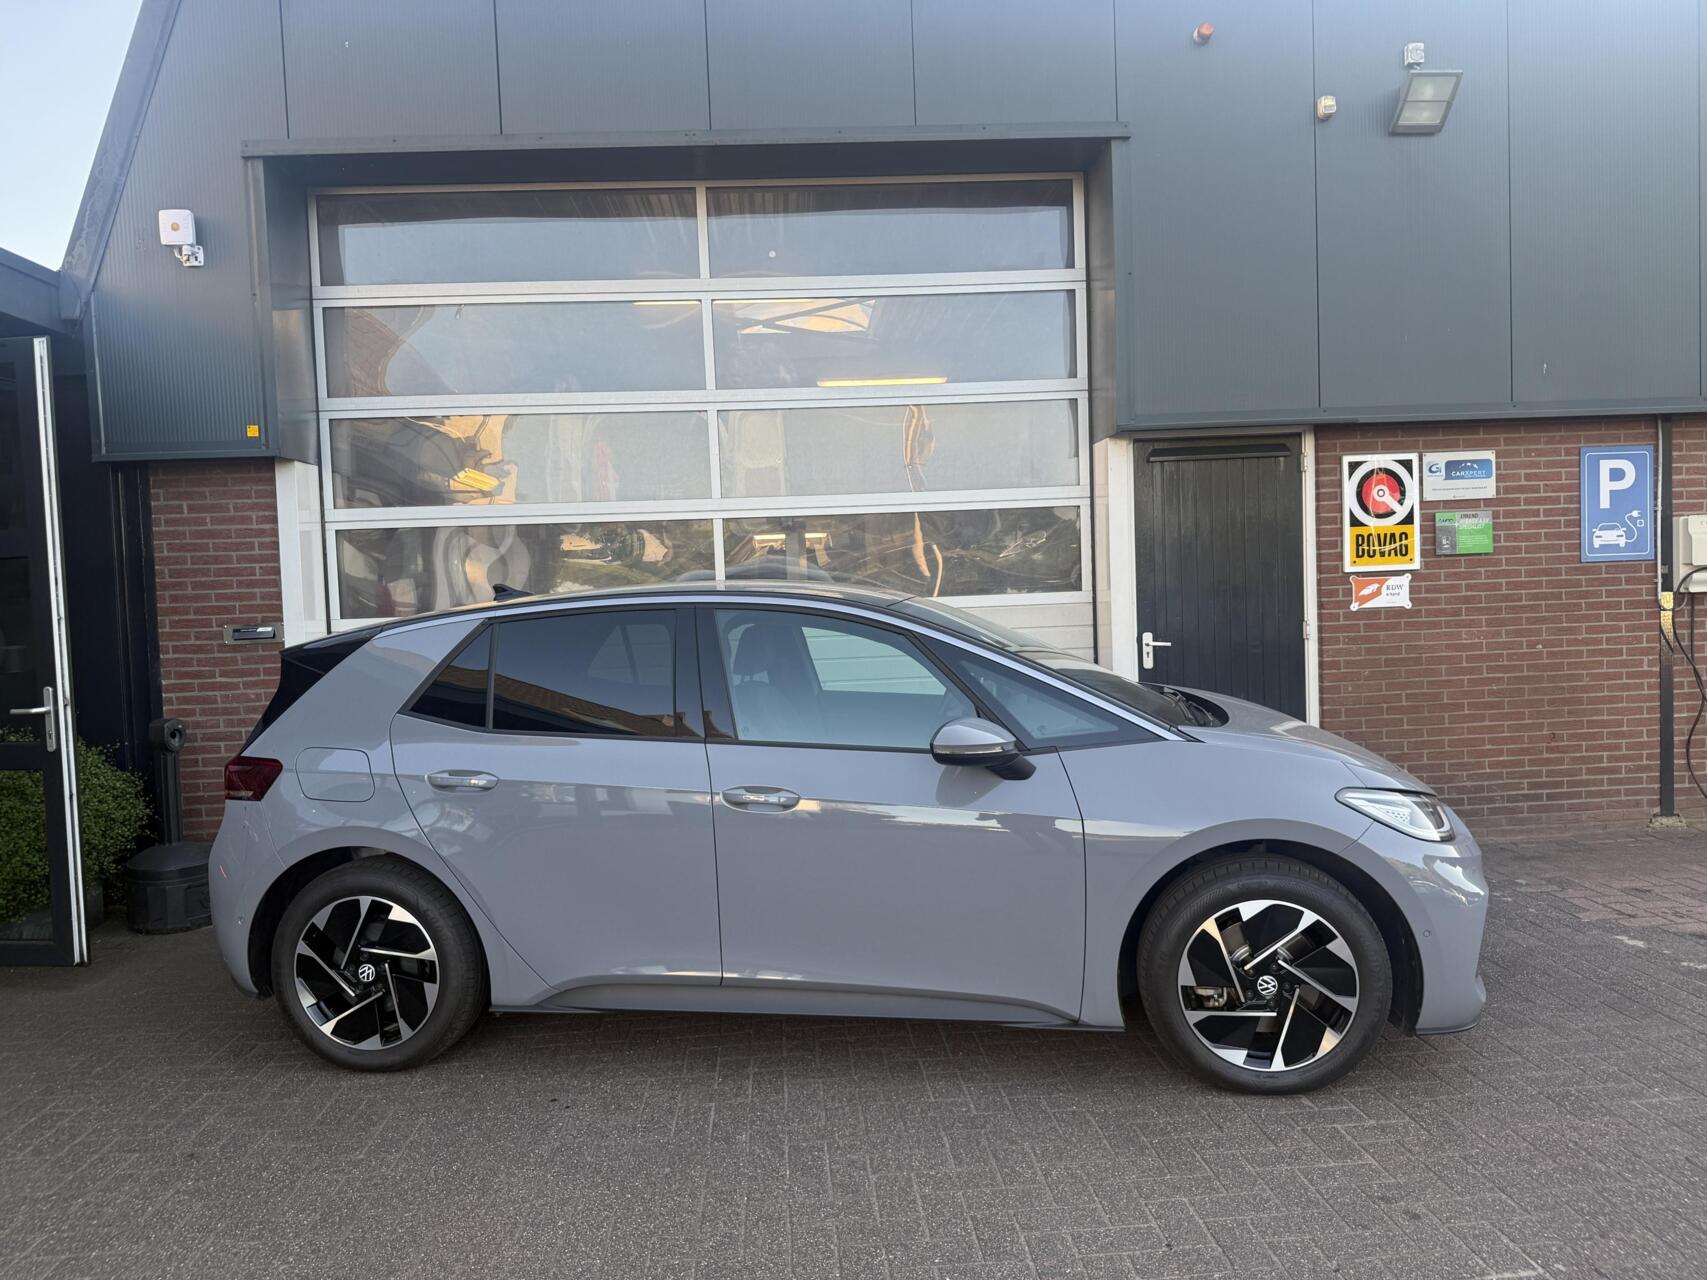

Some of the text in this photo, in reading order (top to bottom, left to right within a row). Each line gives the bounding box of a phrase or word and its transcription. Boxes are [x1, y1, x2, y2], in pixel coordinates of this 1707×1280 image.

[1599, 459, 1636, 509] P
[1355, 531, 1409, 559] BOVAG
[1386, 583, 1404, 591] RDW
